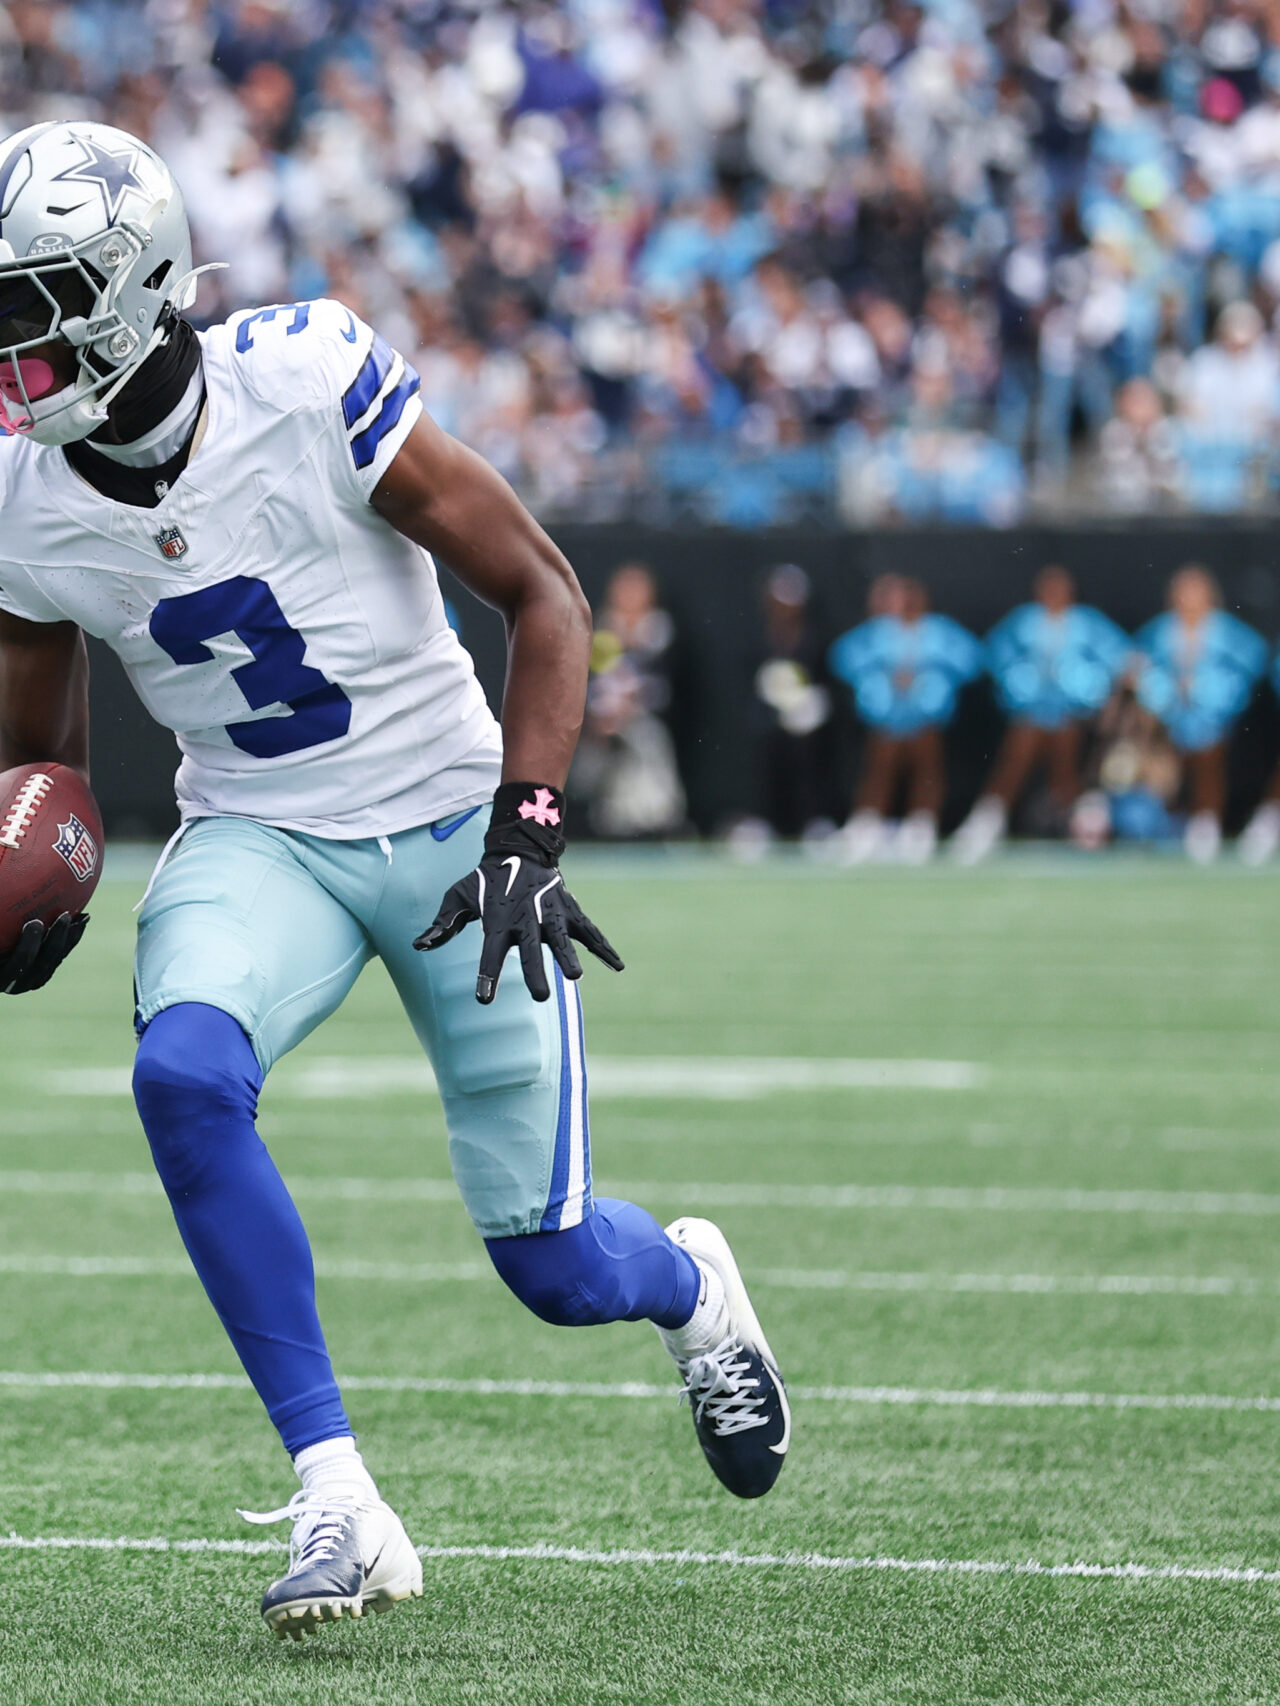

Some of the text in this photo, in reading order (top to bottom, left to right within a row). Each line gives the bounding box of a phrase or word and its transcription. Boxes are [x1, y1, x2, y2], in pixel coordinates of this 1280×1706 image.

[235, 303, 311, 354] 3
[162, 539, 185, 556] NFL
[149, 575, 353, 759] 3
[71, 836, 96, 876] NFL
